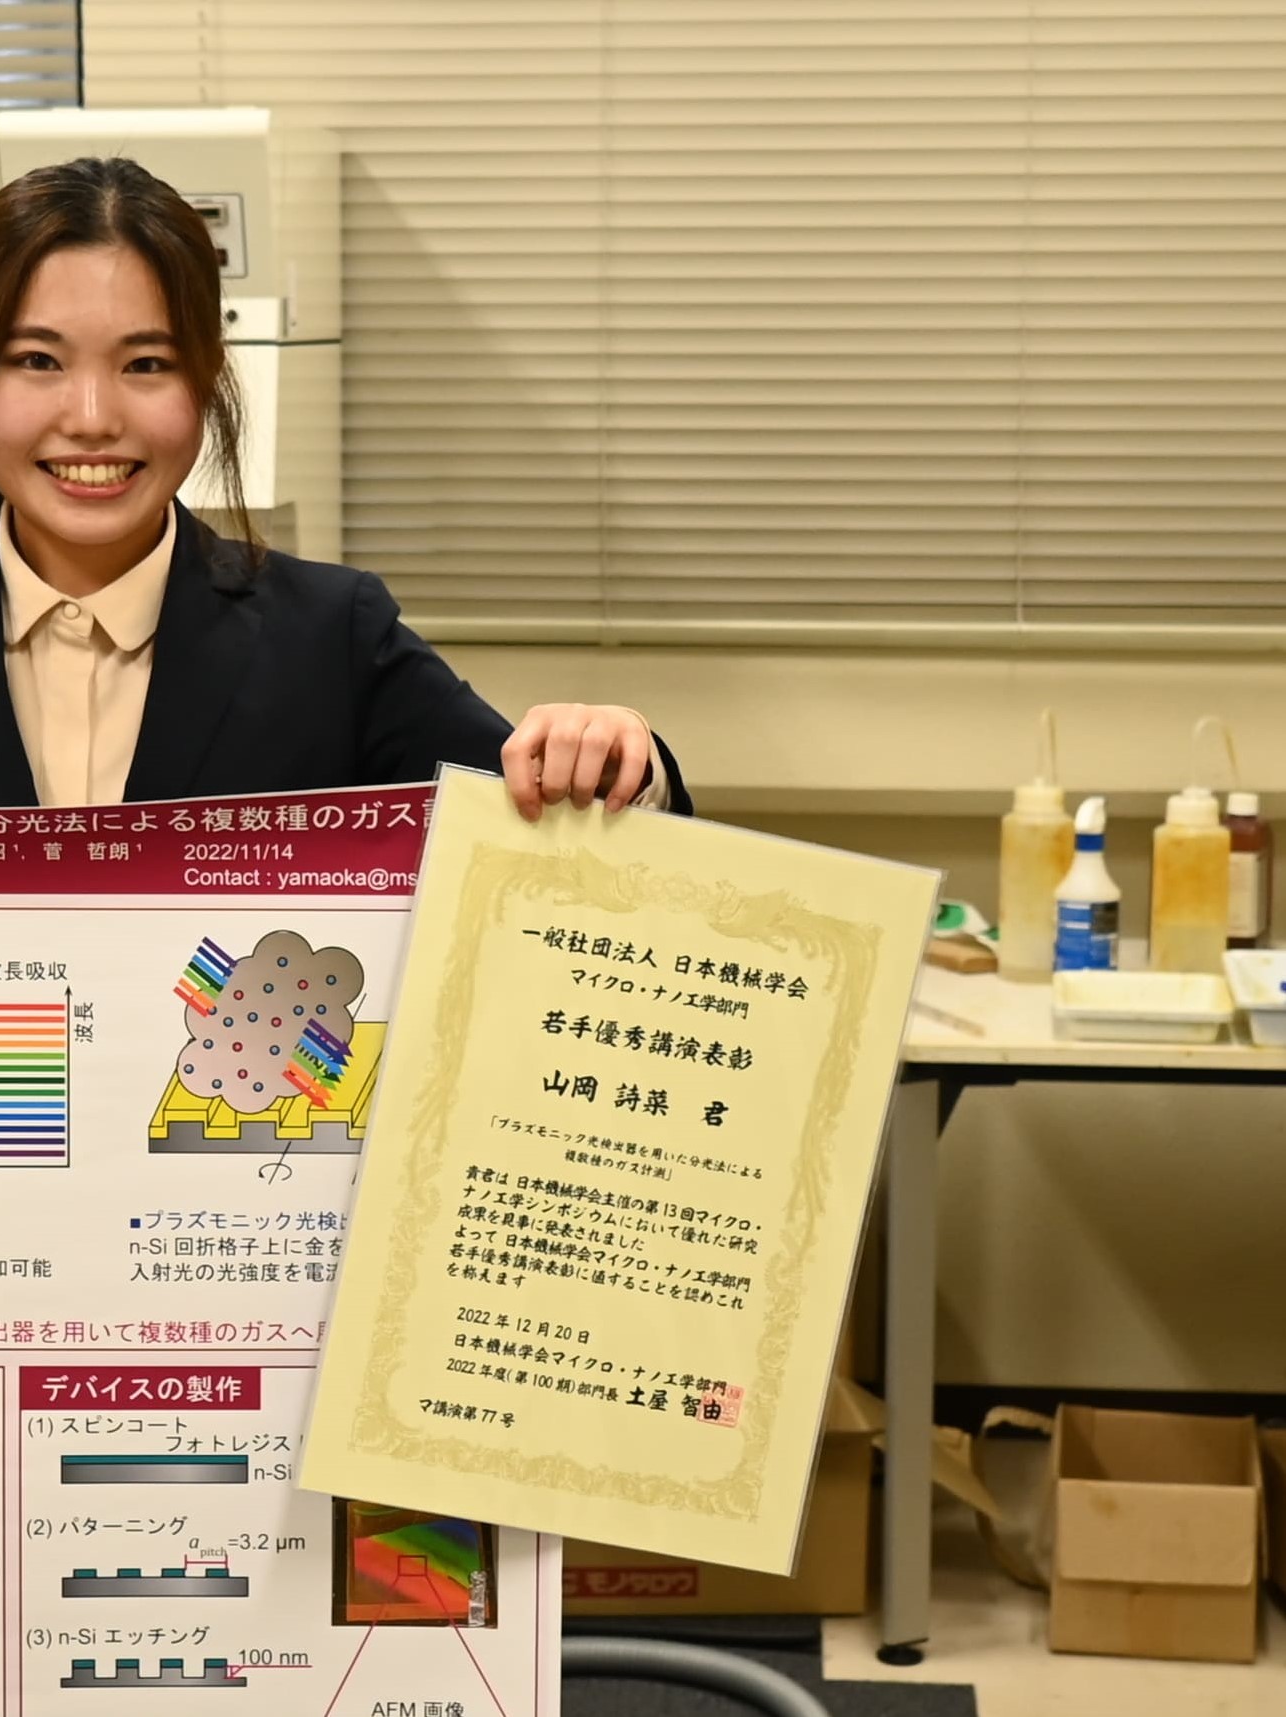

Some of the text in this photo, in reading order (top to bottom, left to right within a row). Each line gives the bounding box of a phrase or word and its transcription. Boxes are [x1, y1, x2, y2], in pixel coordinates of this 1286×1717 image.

[183, 843, 294, 862] 2022/11/14
[184, 867, 260, 887] Contact
[522, 926, 810, 1001] 一般社団法人 日本機械学会
[541, 1009, 754, 1072] 若手優秀講演表彰
[42, 1375, 243, 1403] デバイスの製作
[239, 1649, 308, 1665] 100 nm
